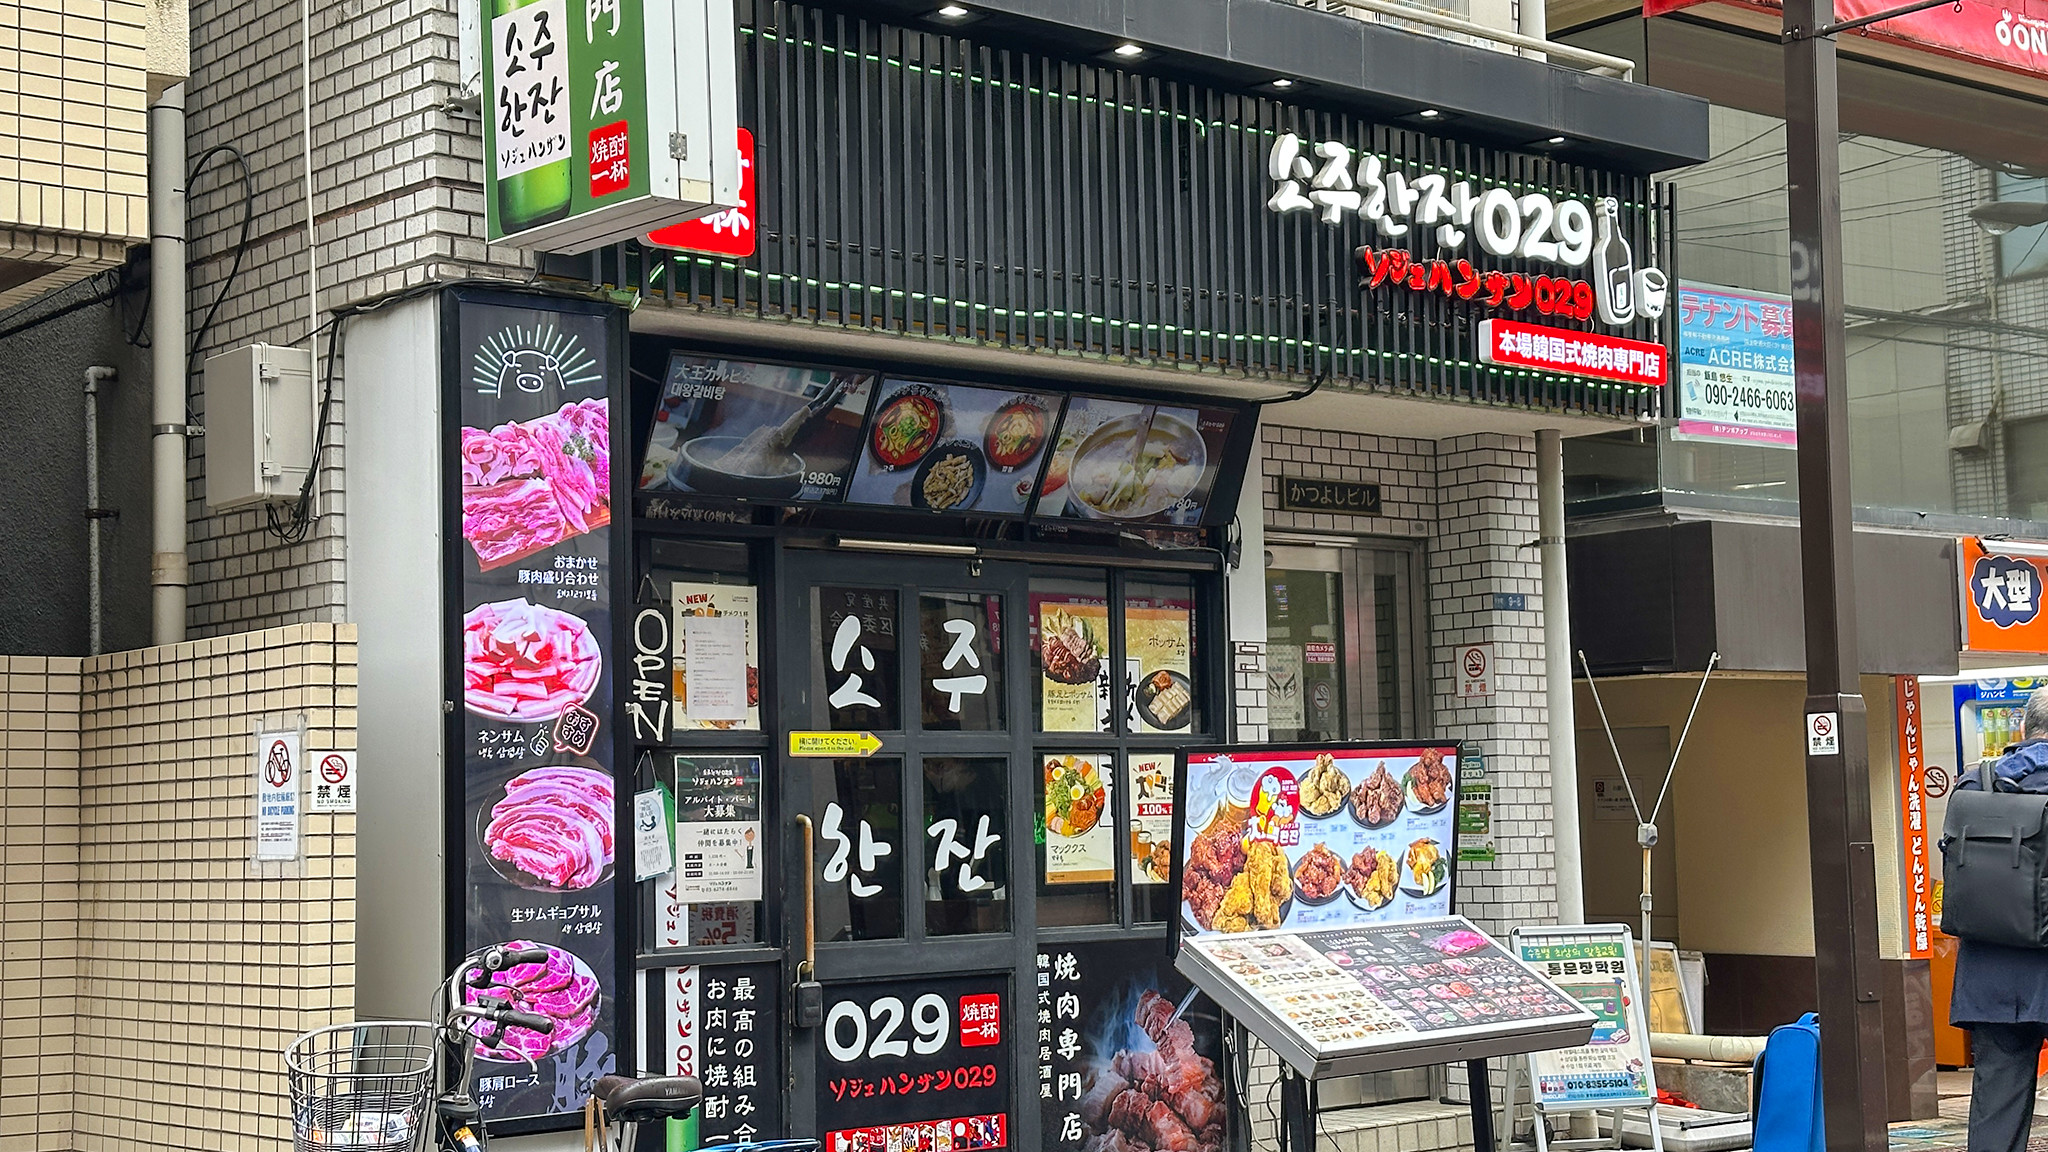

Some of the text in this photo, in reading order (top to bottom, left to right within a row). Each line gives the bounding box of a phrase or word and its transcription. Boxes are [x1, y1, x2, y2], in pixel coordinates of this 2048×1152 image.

[505, 10, 556, 78] 소주
[500, 76, 564, 138] 한잔
[591, 132, 628, 165] 焼酎
[591, 159, 629, 183] 一杯
[1498, 330, 1661, 379] 本場韓国式焼肉専門店
[1685, 346, 1705, 357] ACRE
[1708, 348, 1795, 374] ACRE株式会
[670, 382, 727, 400] 대왕갈비탕
[1705, 383, 1795, 412] 090-2466-6063
[799, 471, 842, 487] 1,980円
[1290, 482, 1376, 507] かつよしビル
[554, 555, 599, 570] おまかせ
[517, 570, 599, 587] 豚肉盛り合わせ
[1980, 566, 2033, 612] 大型
[686, 593, 708, 604] NEW
[625, 608, 669, 742] OPEN
[829, 614, 988, 713] 소주
[477, 729, 525, 744] ネンサム
[1138, 762, 1156, 772] NEW
[317, 785, 351, 798] 禁煙
[704, 805, 736, 818] 大募集
[1903, 679, 1928, 952] じゃんじゃん洗濯 どんどん乾燥
[821, 802, 1001, 898] 한잔
[511, 905, 603, 923] 生サムギョプサル
[962, 1002, 998, 1021] 焼酎
[825, 993, 950, 1062] 029
[962, 1022, 998, 1038] 一杯
[1036, 954, 1053, 1099] 韓国式焼肉居酒屋
[1054, 952, 1083, 1142] 焼肉専門店
[479, 1073, 540, 1092] 豚肩ロース
[829, 1064, 997, 1102] ソジュハンザン029
